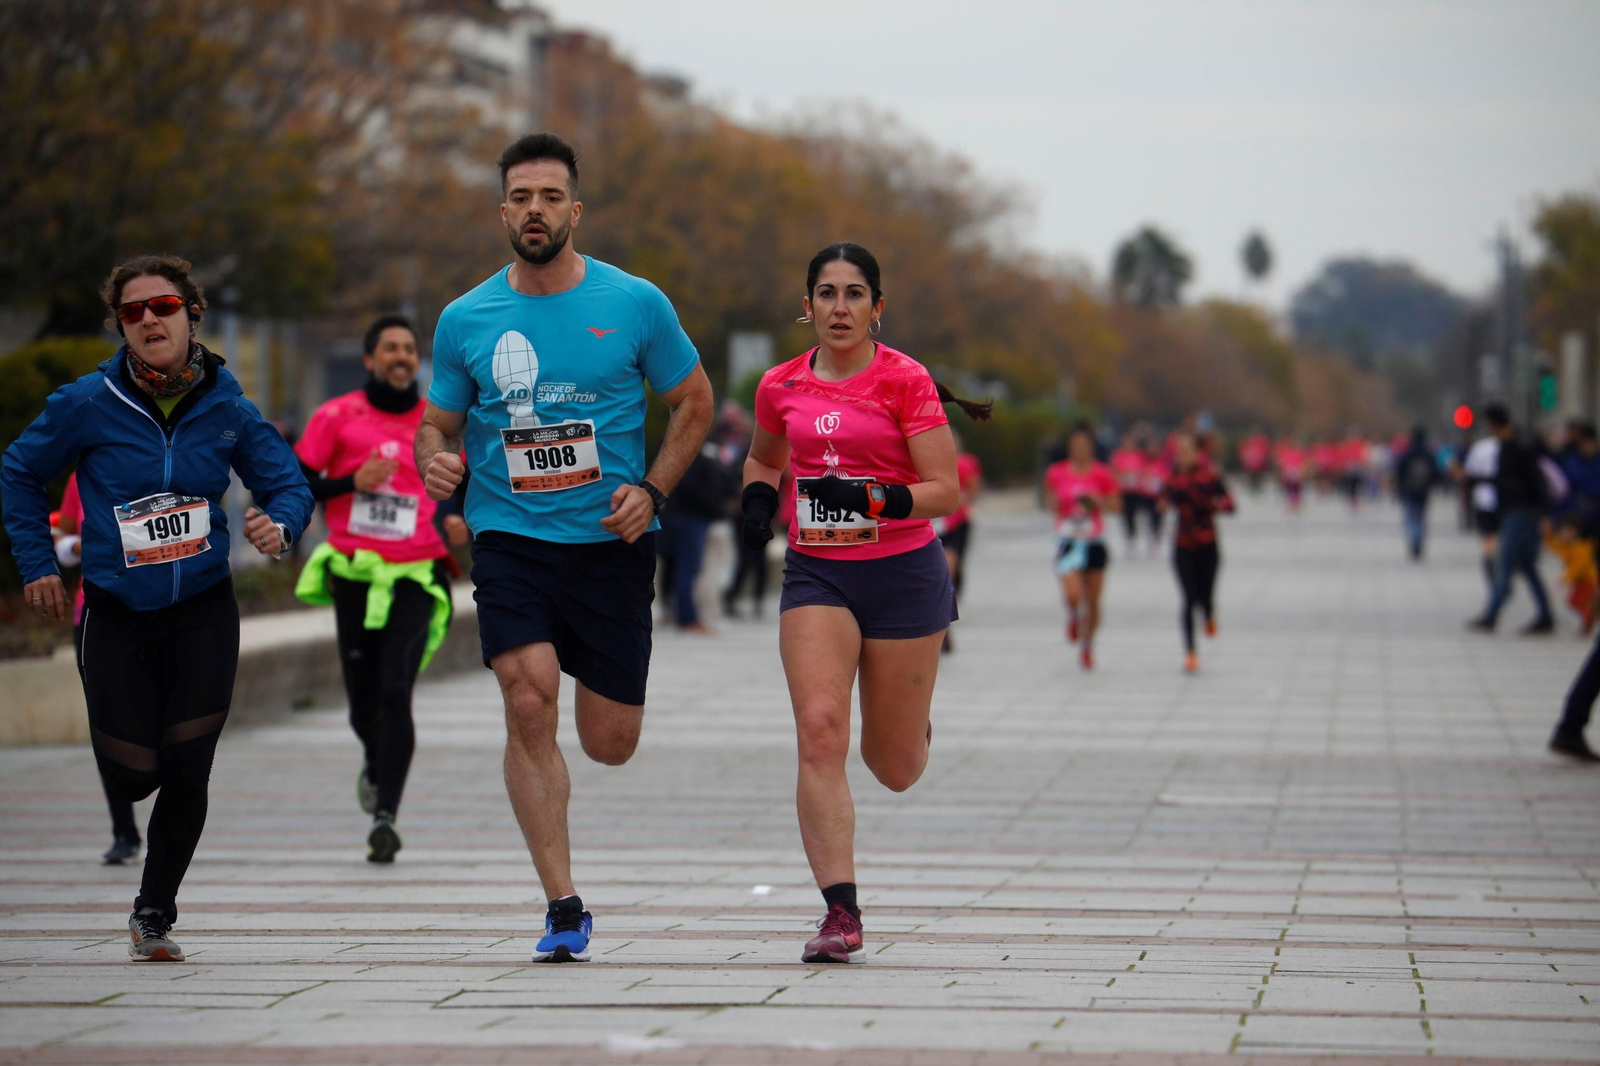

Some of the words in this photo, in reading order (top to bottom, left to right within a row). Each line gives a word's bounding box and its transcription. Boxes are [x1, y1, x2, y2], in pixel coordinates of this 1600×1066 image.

[505, 388, 528, 400] 40
[538, 385, 564, 393] NOCHE
[564, 386, 577, 394] DE
[536, 393, 558, 403] SAN
[557, 391, 597, 403] ANTÓN
[524, 445, 577, 470] 1908
[143, 511, 190, 541] 1907
